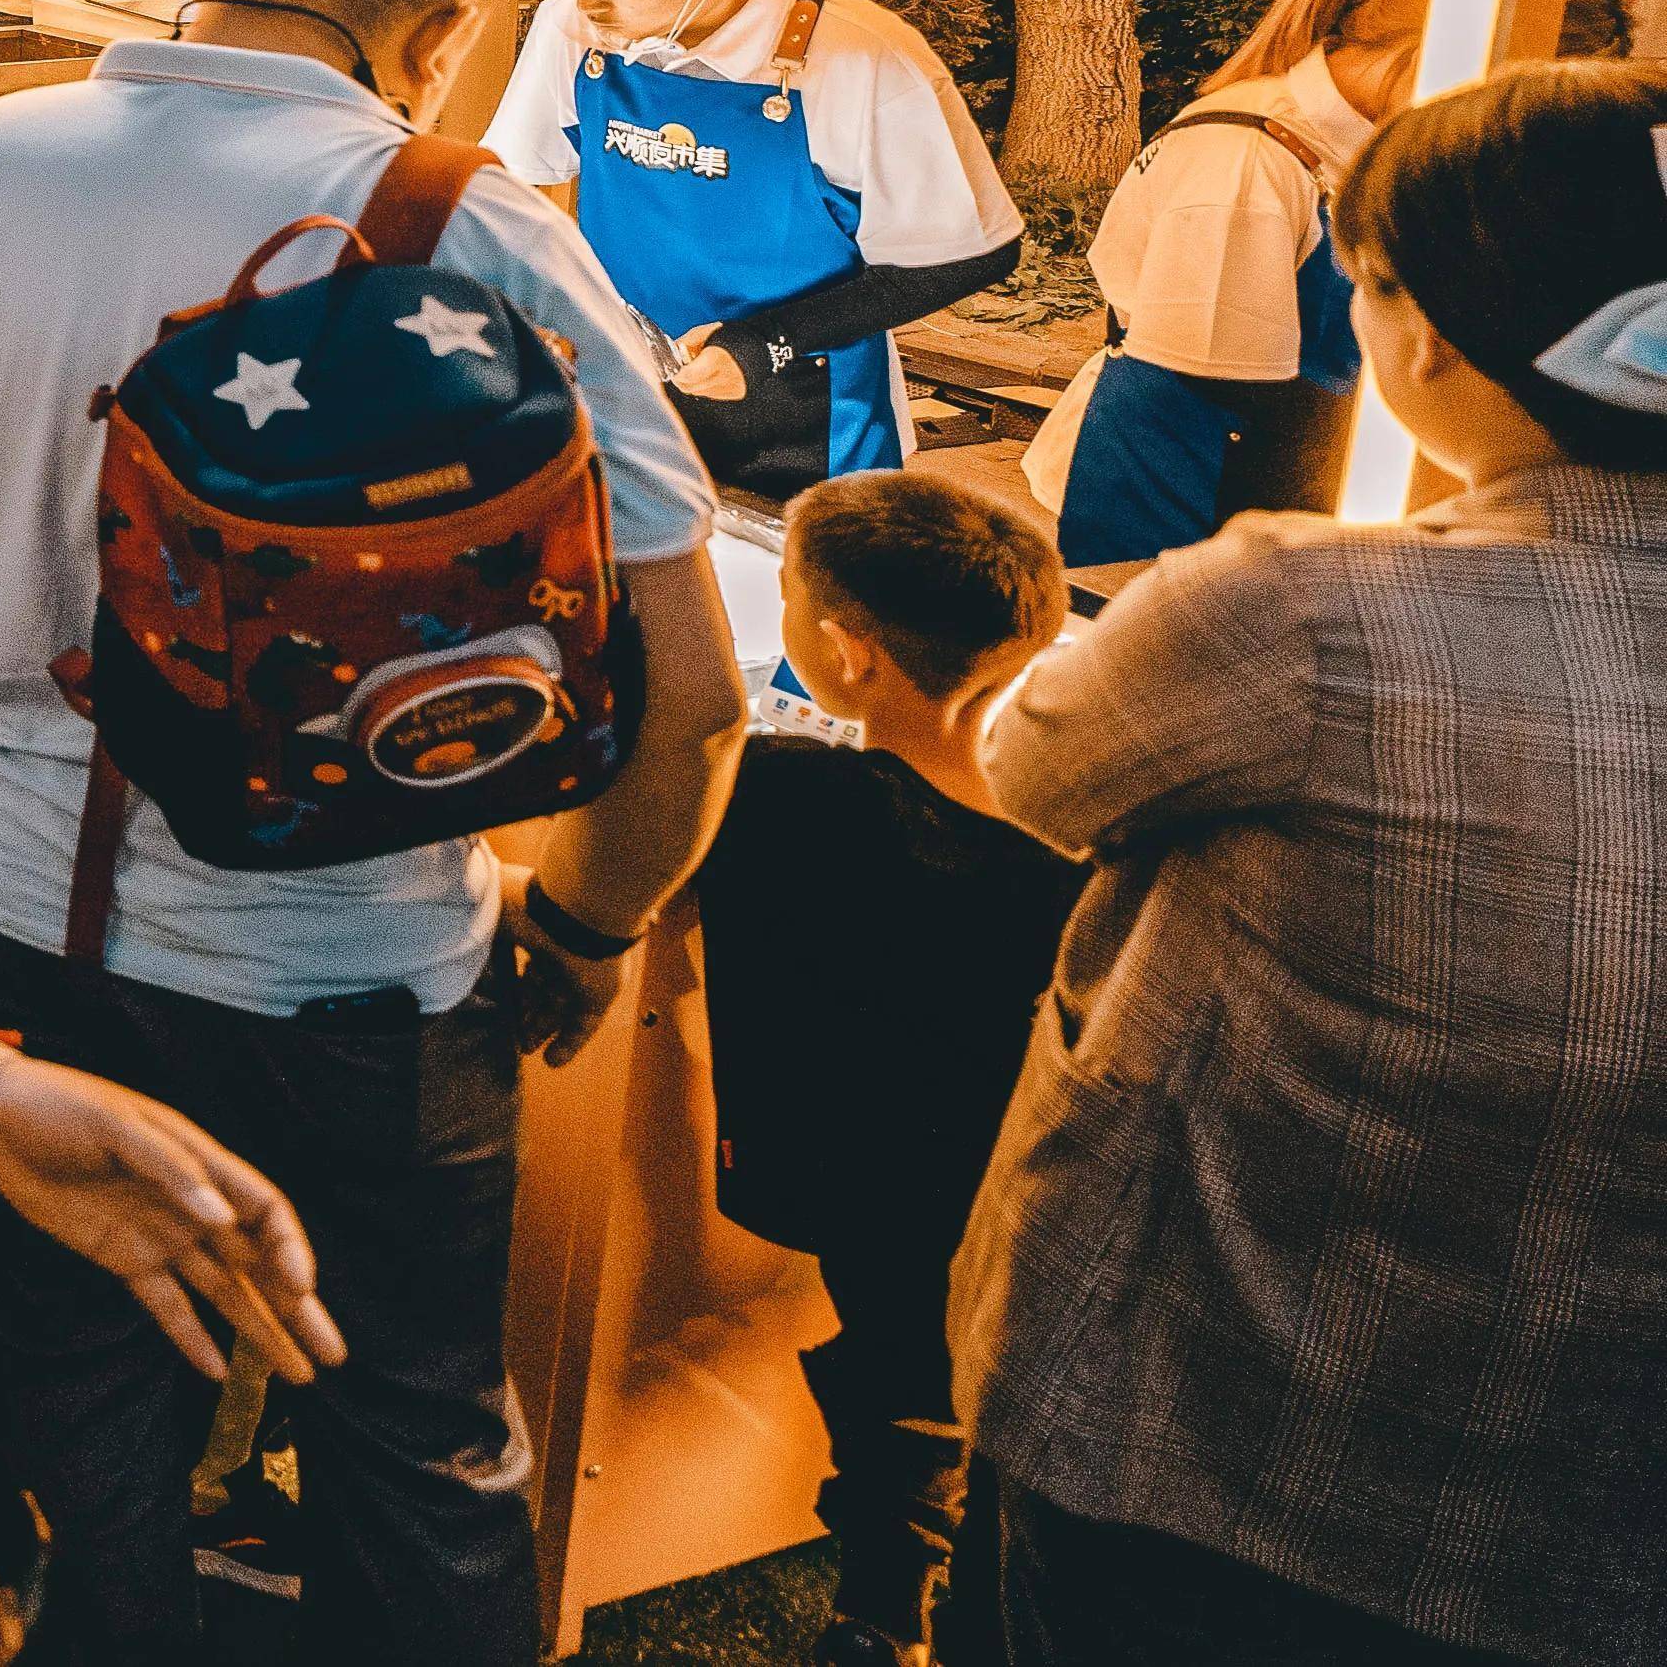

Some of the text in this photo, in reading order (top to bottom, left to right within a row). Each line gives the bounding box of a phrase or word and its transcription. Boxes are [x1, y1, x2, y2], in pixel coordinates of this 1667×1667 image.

[605, 129, 729, 179] 兴顺夜市集
